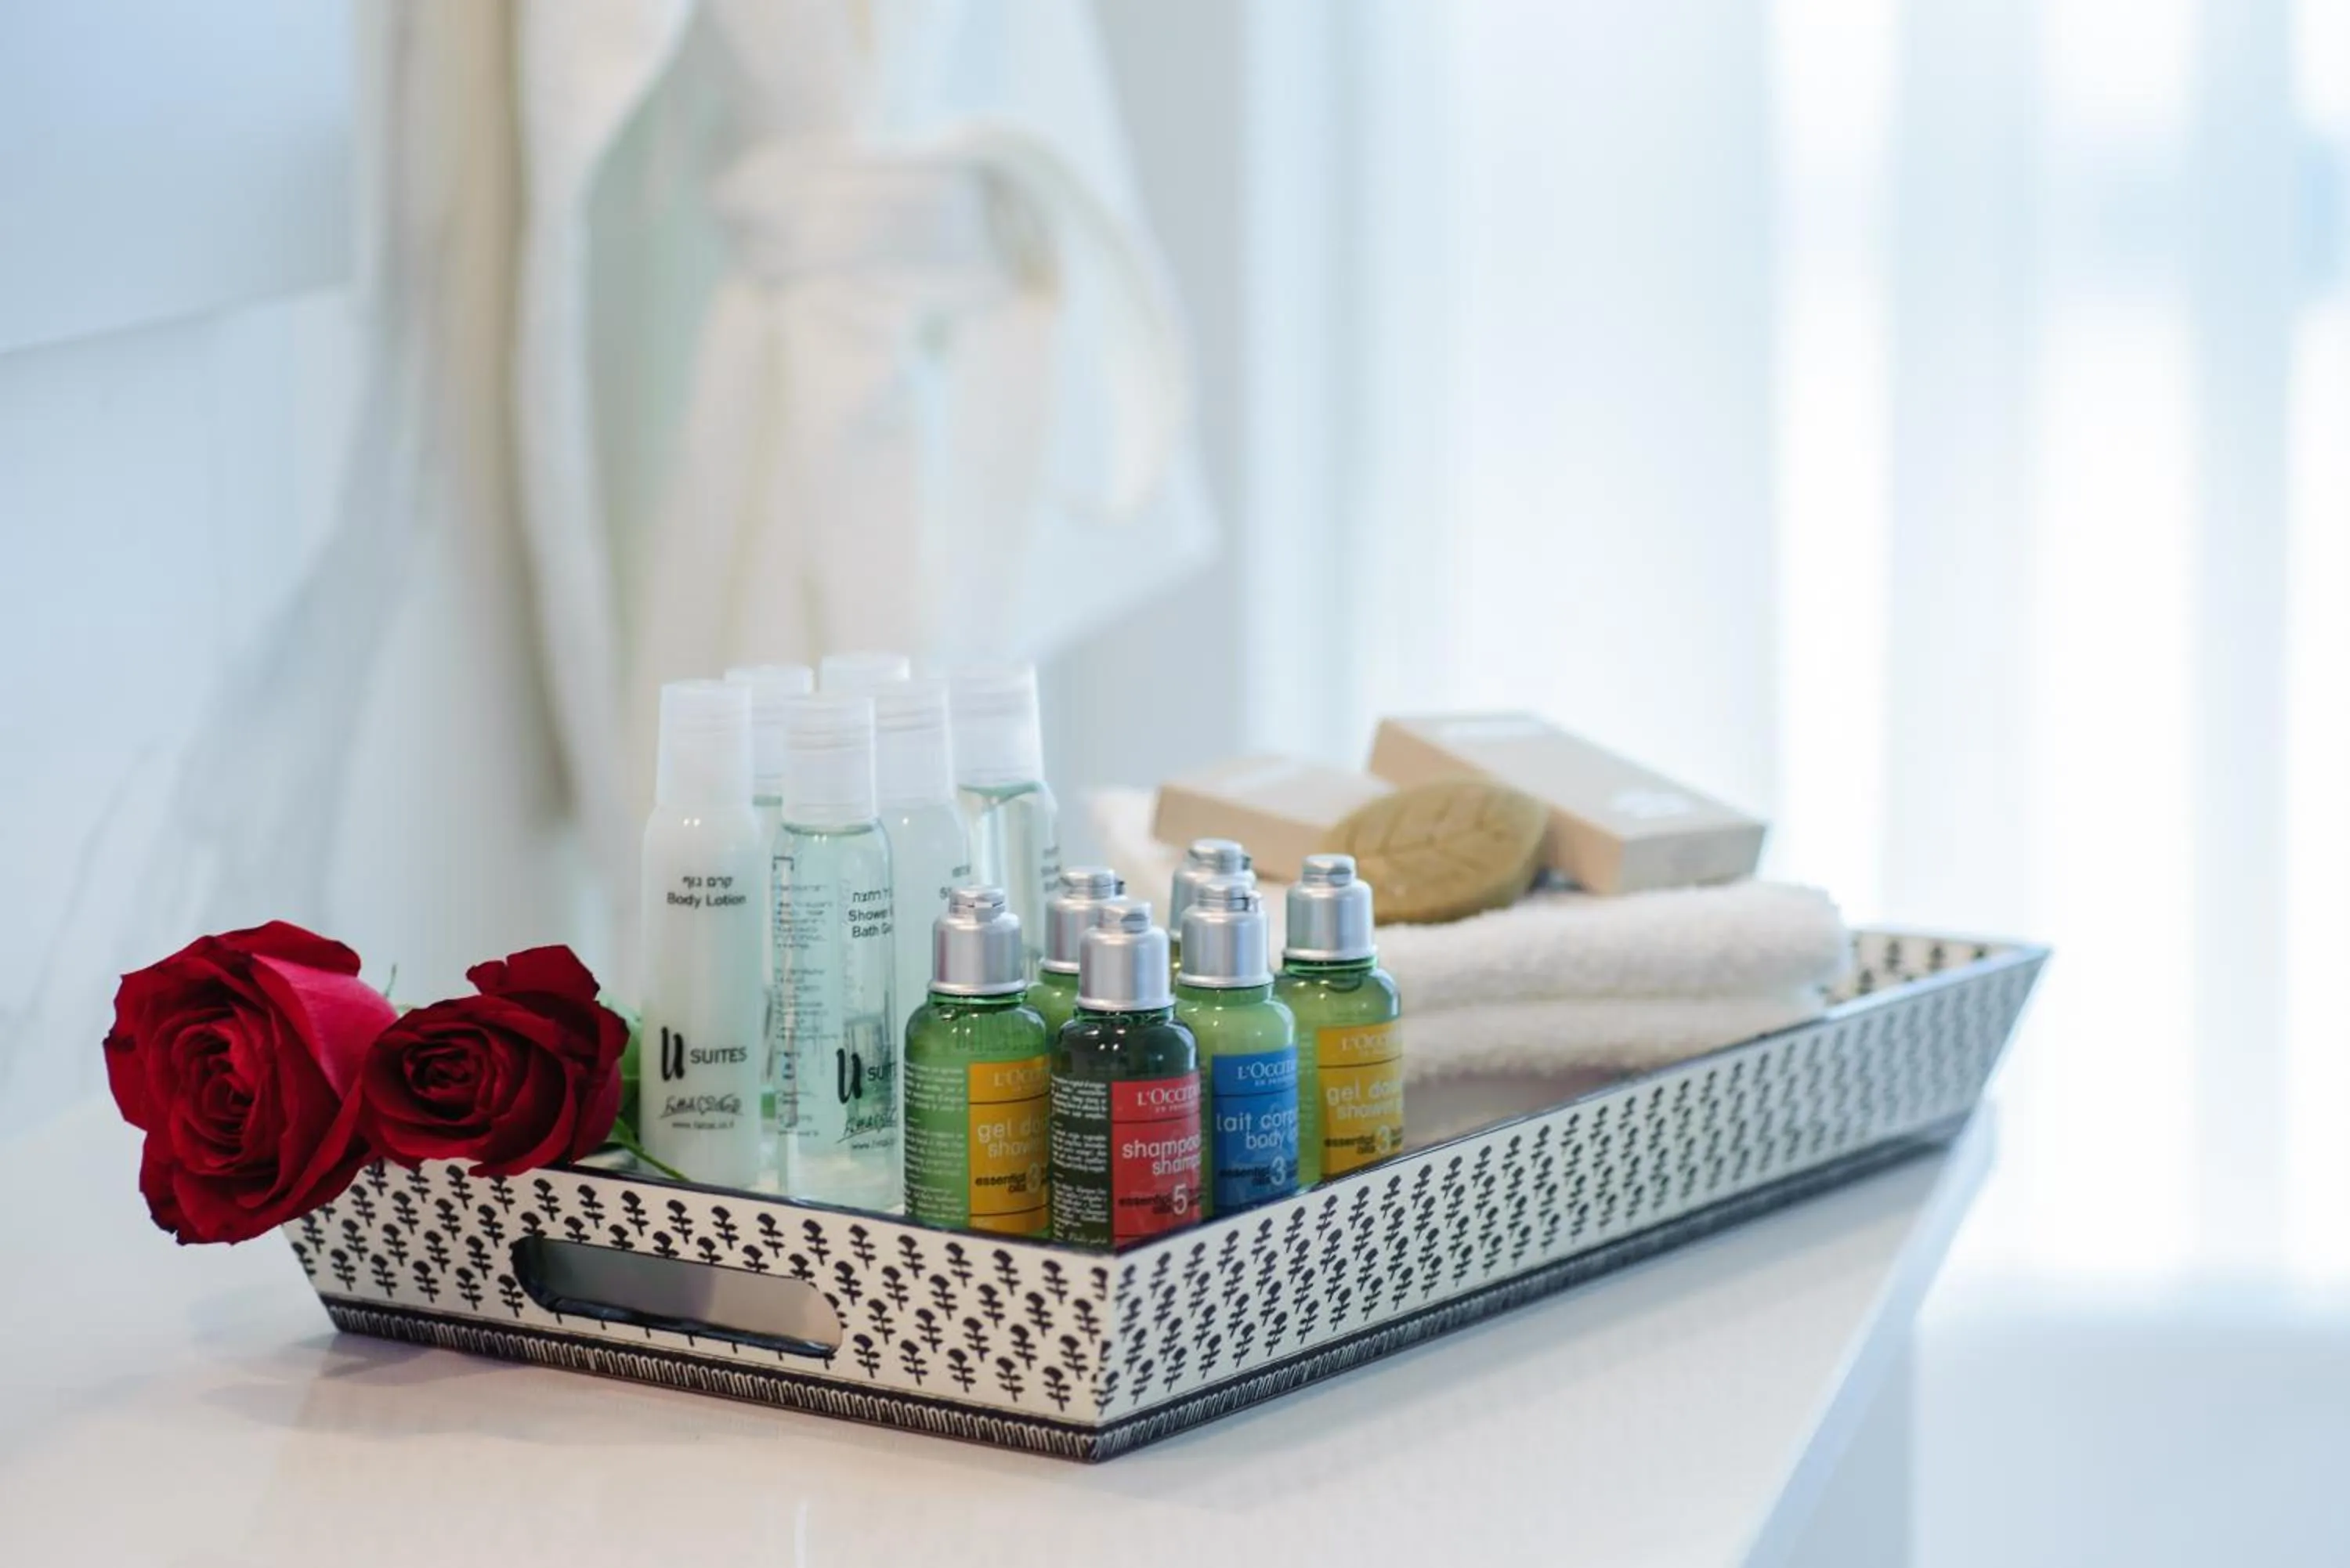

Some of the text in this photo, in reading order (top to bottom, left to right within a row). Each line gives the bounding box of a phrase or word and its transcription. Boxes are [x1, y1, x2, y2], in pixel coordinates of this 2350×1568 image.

[667, 892, 747, 909] Body Lotion
[852, 925, 879, 938] Bath
[690, 1047, 748, 1064] SUITES
[1327, 1078, 1361, 1106] gel
[978, 1118, 1011, 1143] gel
[1217, 1112, 1252, 1132] lait
[1246, 1128, 1285, 1150] body
[1271, 1156, 1286, 1186] 3
[1173, 1183, 1188, 1216] 5
